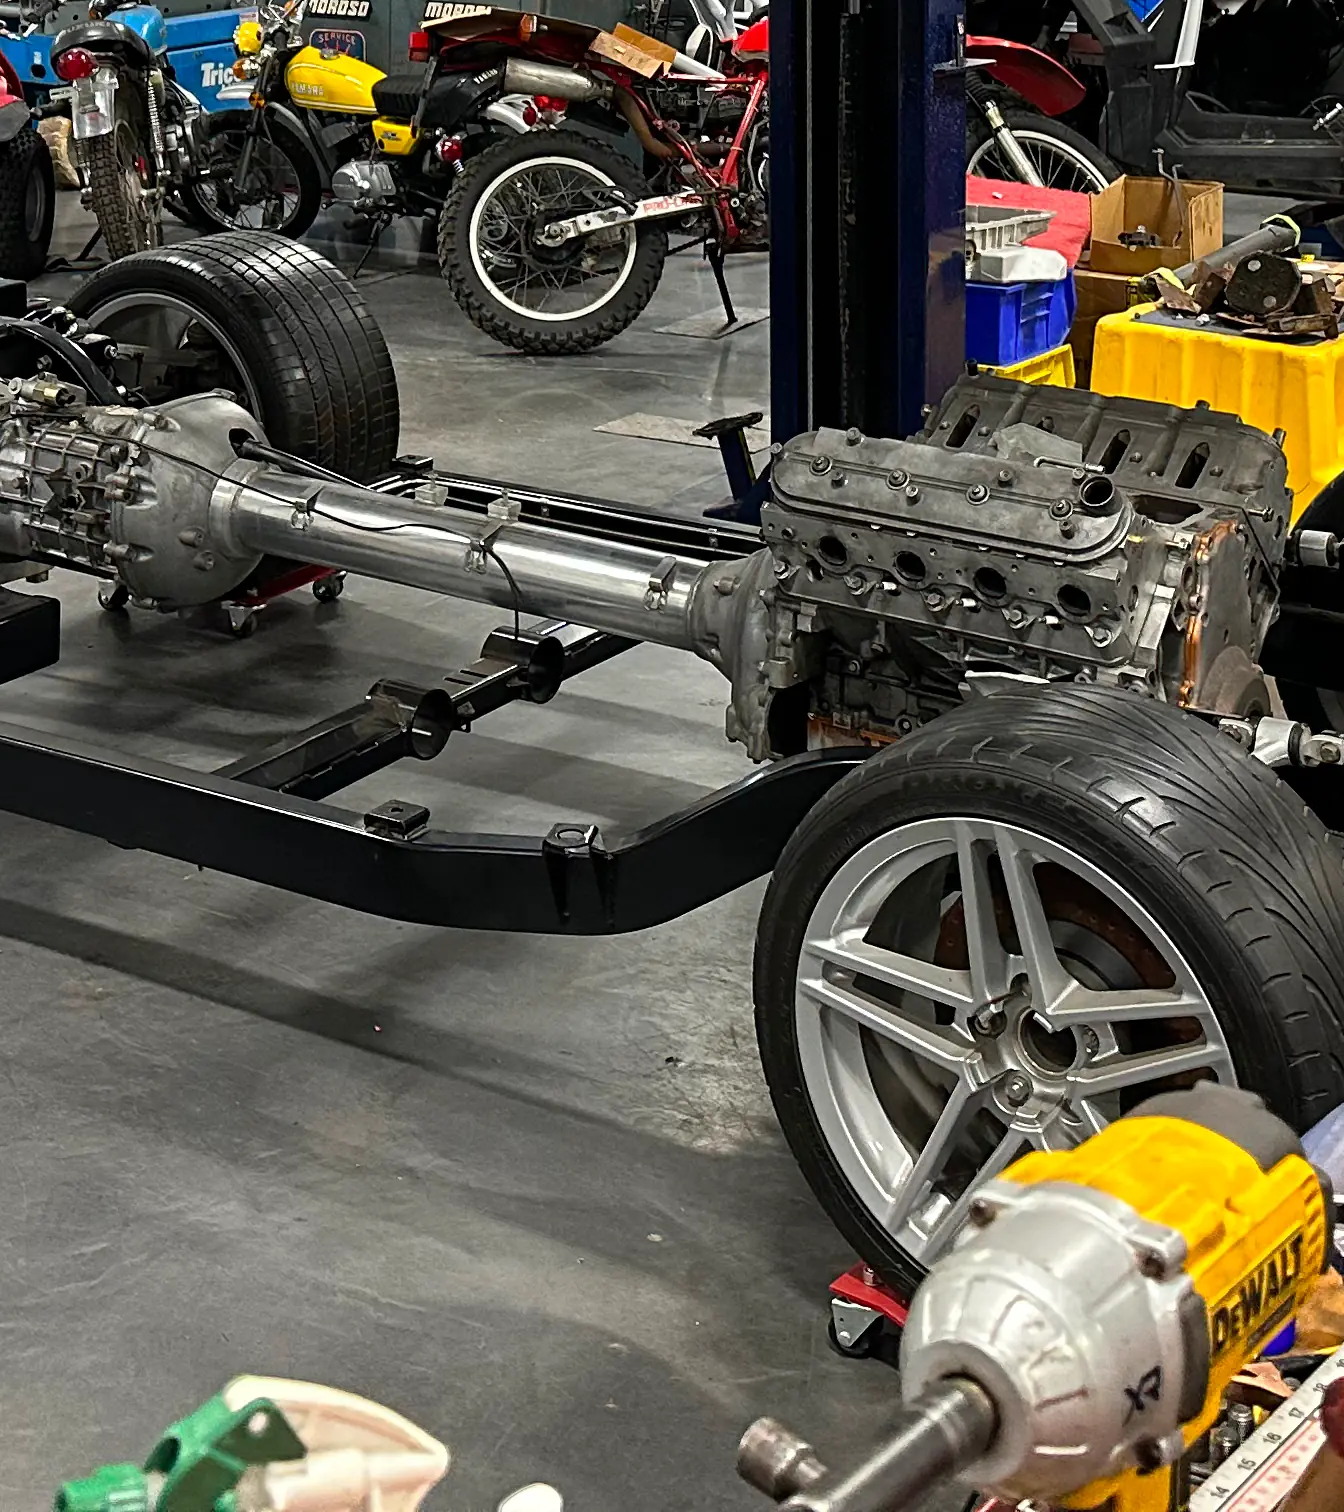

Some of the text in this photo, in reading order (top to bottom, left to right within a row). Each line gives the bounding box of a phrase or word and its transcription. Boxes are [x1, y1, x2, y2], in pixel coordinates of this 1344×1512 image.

[317, 31, 357, 46] SERVICE
[200, 62, 237, 88] Tric
[1288, 1406, 1306, 1420] 17
[1262, 1430, 1283, 1446] 16
[1237, 1456, 1257, 1472] 15
[1209, 1484, 1230, 1500] 14
